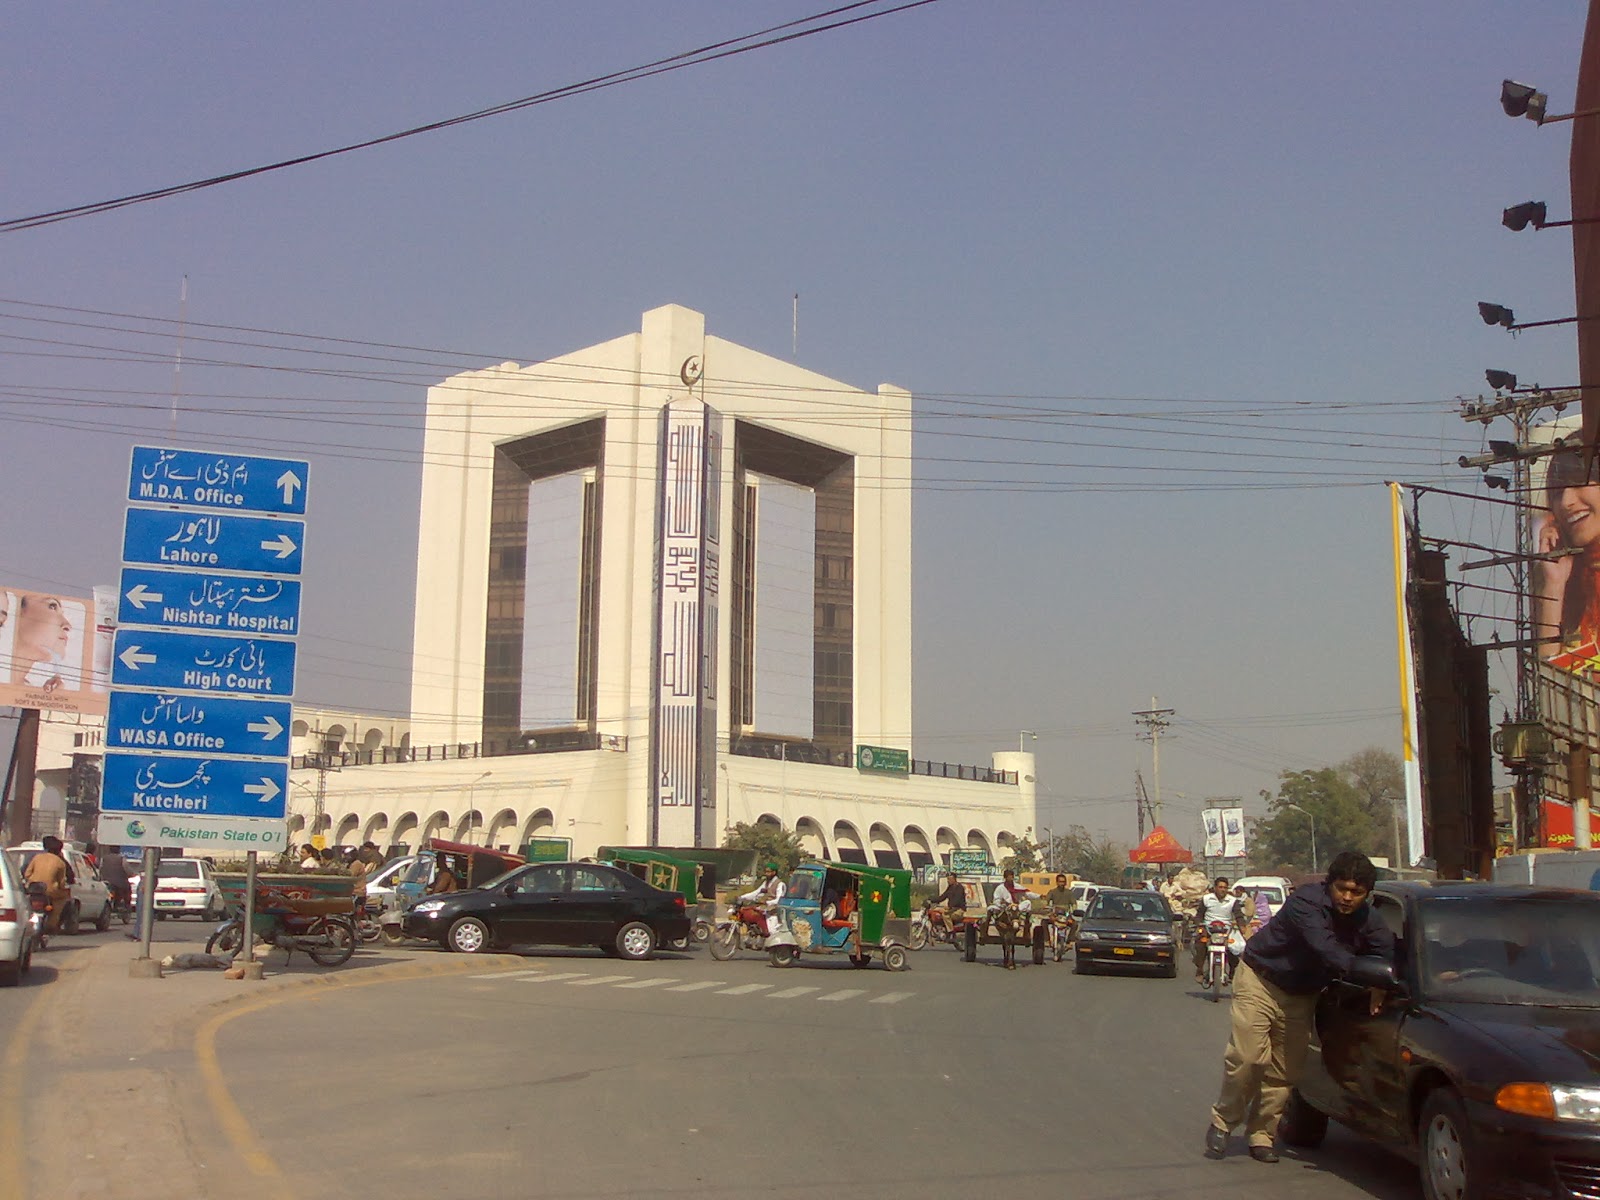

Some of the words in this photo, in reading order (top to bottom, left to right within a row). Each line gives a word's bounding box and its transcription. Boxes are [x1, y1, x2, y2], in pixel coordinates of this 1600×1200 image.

[143, 449, 178, 479] آفس
[205, 459, 229, 485] ڈی
[232, 463, 247, 487] ایم
[139, 483, 188, 501] M.D.A.
[193, 488, 243, 506] Office
[166, 517, 220, 544] لاہور
[160, 546, 218, 565] Lahore
[190, 580, 234, 609] ہسپتال
[232, 581, 282, 610] نشتر
[162, 607, 222, 626] Nishtar
[227, 613, 293, 631] Hospital
[196, 648, 240, 667] کورٹ
[241, 639, 266, 675] ہائی
[184, 671, 221, 690] High
[226, 673, 271, 690] Court
[142, 695, 178, 724] آفس
[177, 705, 204, 723] واسا
[120, 729, 168, 745] WASA
[174, 732, 224, 748] Office
[136, 761, 210, 789] کچہری
[133, 793, 207, 809] Kutcheri
[159, 826, 218, 840] Pakistan
[223, 829, 258, 842] State
[261, 831, 281, 843] Ol
